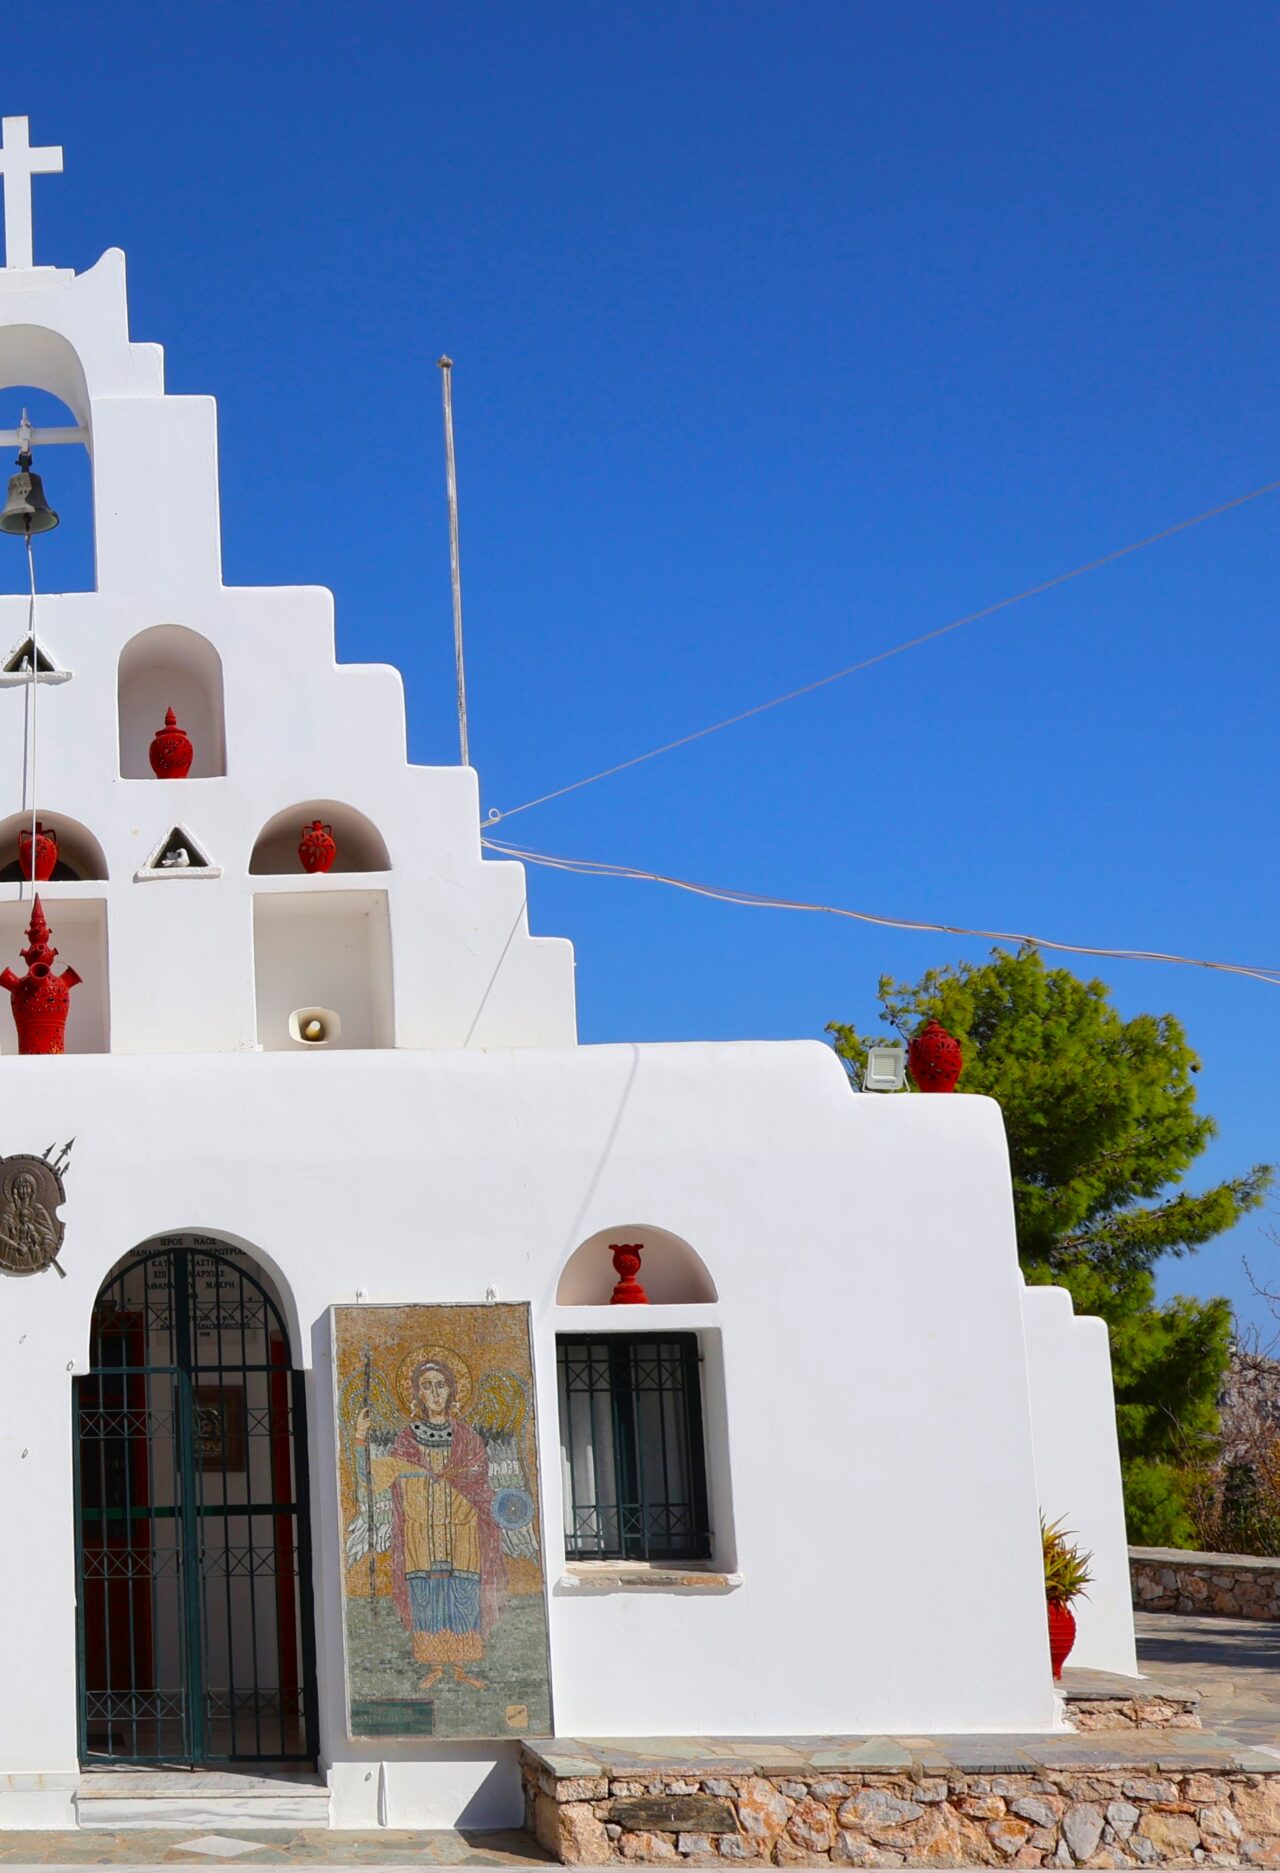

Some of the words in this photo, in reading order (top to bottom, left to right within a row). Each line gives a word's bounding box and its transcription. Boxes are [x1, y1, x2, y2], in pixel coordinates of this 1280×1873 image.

[160, 1238, 184, 1246] ΙΕΡΟΣ
[193, 1238, 217, 1246] ΝΑΟΣ
[205, 1281, 235, 1289] ΜΑΚΡΗ
